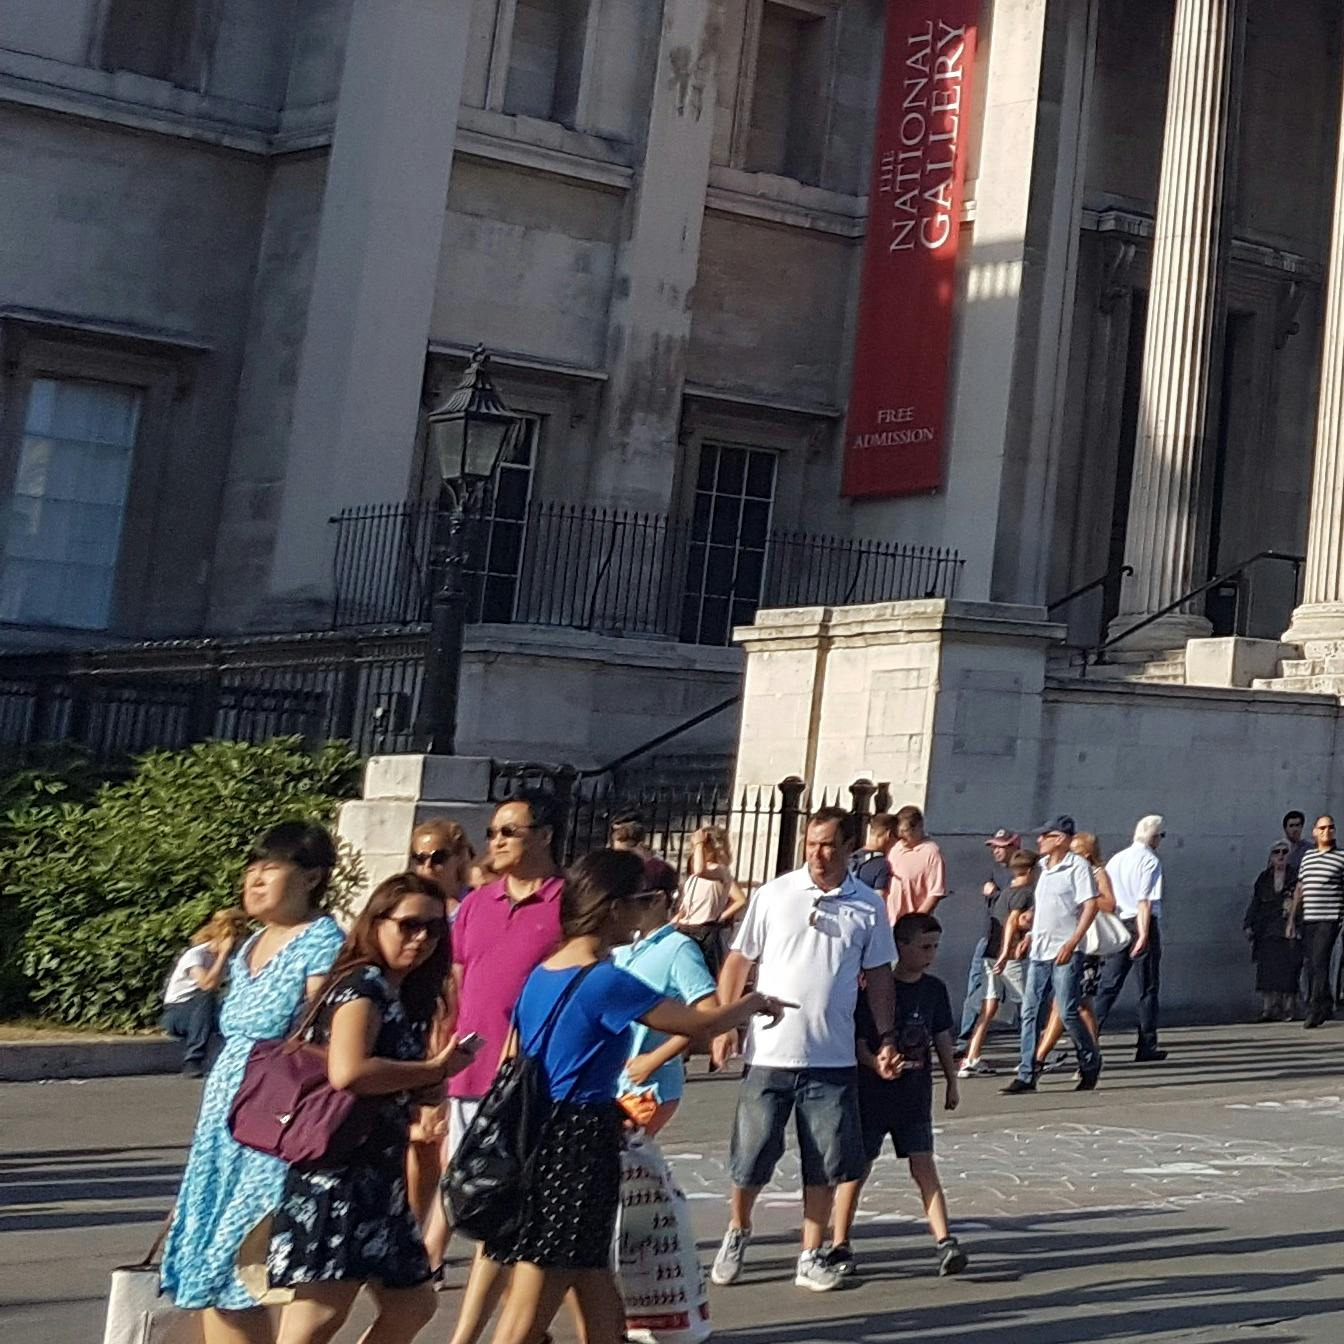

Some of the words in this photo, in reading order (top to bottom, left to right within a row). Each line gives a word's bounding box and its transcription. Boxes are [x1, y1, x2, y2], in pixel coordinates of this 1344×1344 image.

[889, 19, 933, 253] NATIONAL
[919, 18, 966, 250] GALLERY
[880, 150, 895, 193] THE
[852, 426, 934, 448] ADMISSION
[876, 406, 915, 425] FREE
